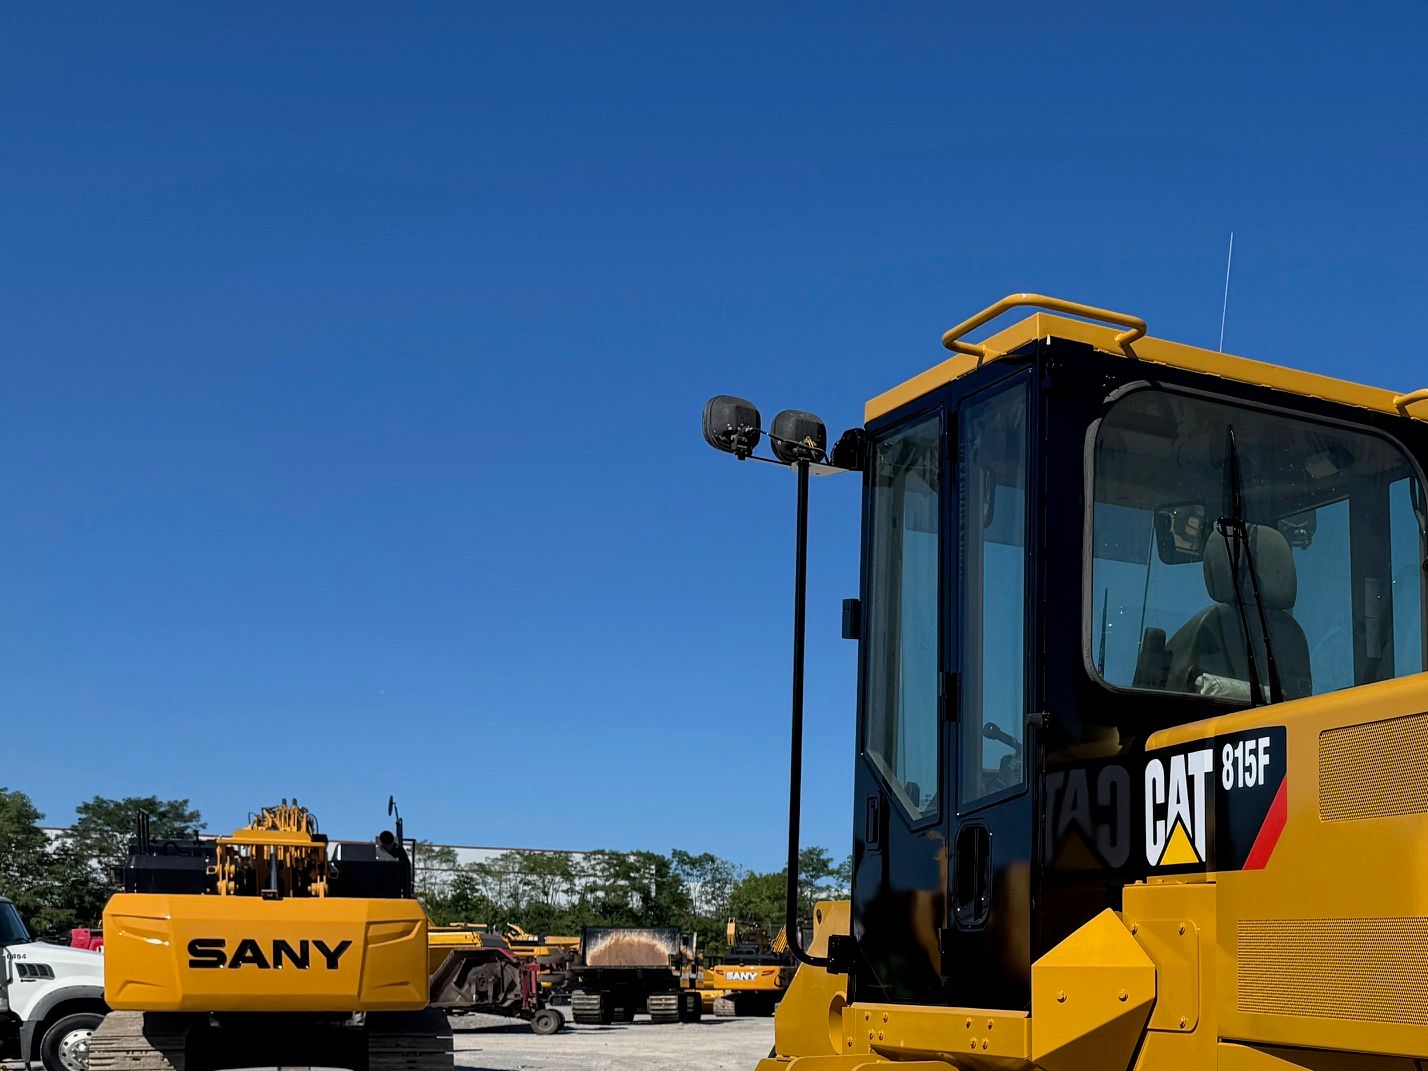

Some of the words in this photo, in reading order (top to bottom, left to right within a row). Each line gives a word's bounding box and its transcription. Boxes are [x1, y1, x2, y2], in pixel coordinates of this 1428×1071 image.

[1144, 748, 1214, 867] CAT
[1221, 736, 1271, 791] 815F
[187, 938, 353, 970] SANY
[726, 971, 758, 981] SANY
